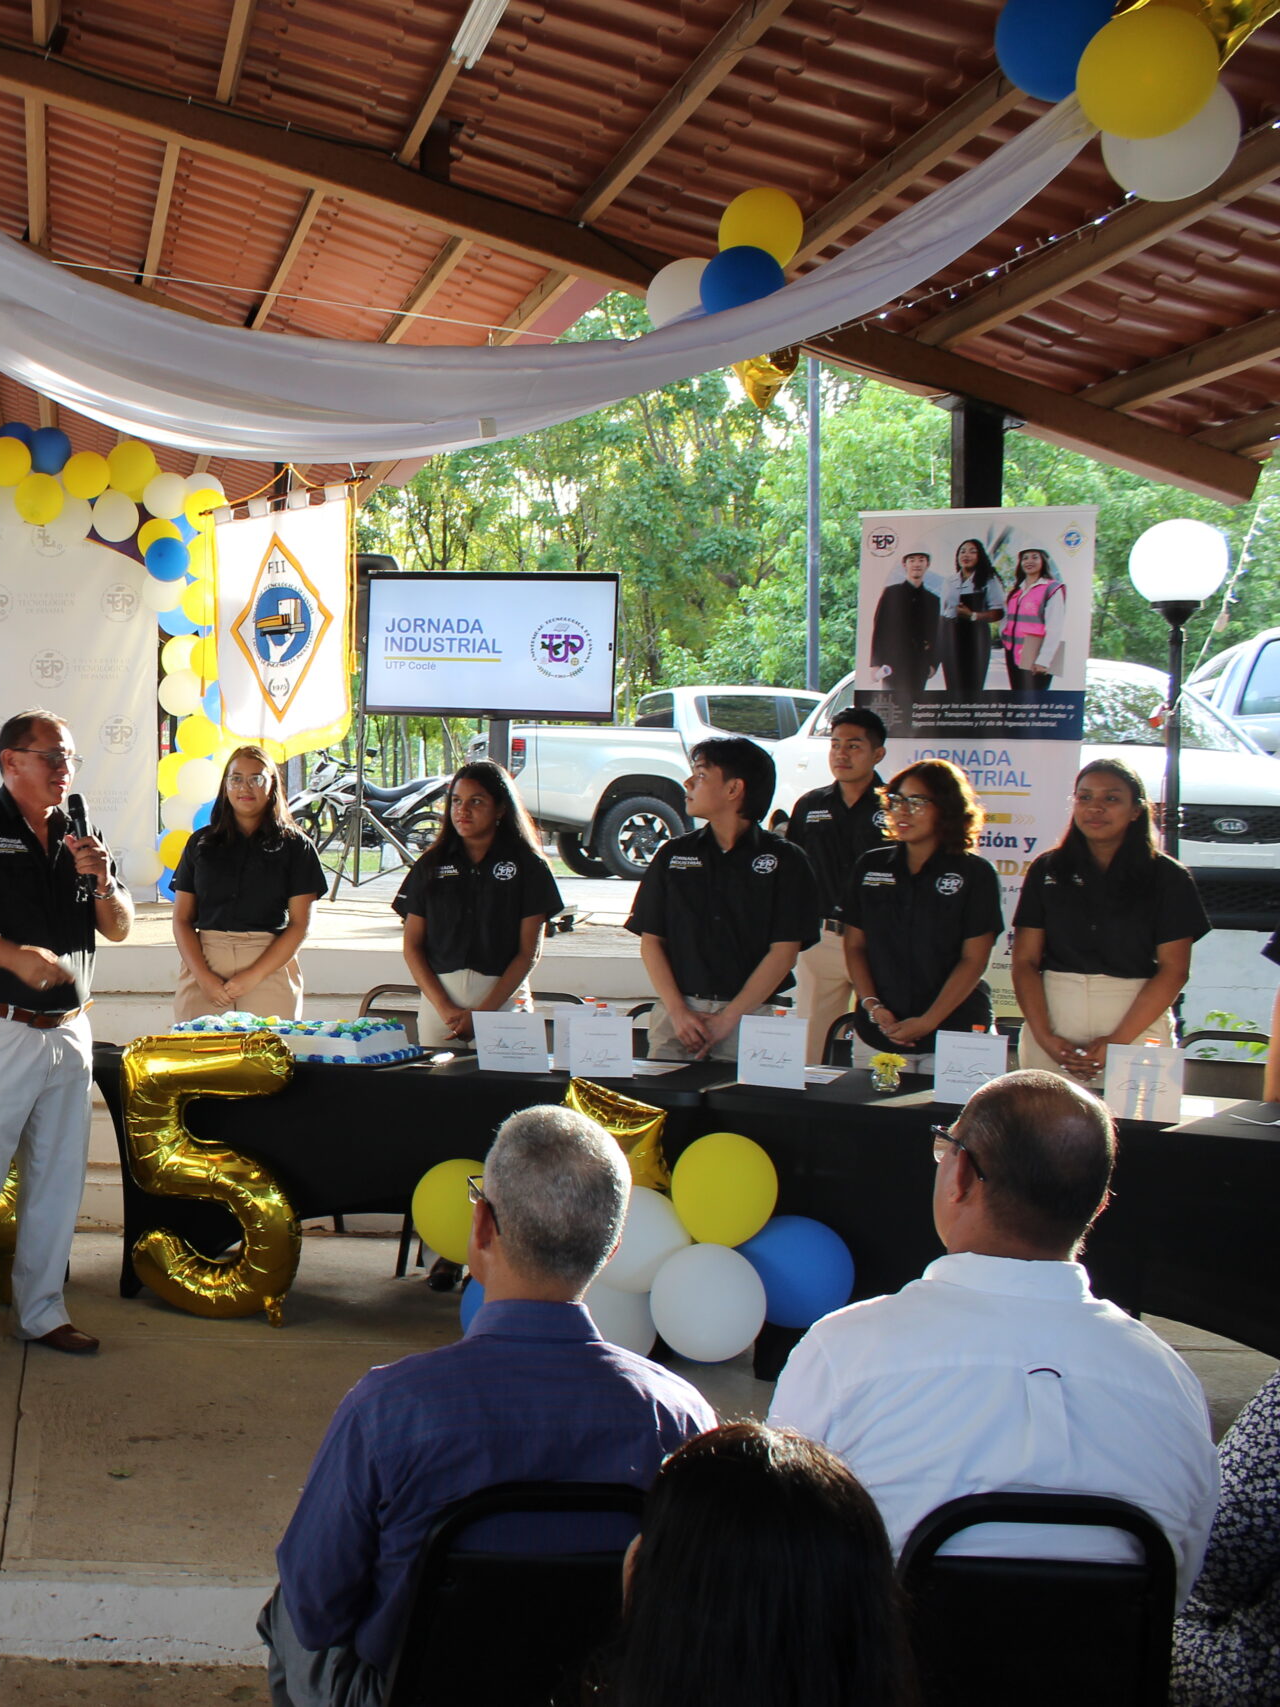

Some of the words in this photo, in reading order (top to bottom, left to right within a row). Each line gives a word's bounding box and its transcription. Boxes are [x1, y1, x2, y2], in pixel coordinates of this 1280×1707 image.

[267, 560, 286, 574] FII
[385, 617, 484, 635] JORNADA
[384, 636, 503, 654] INDUSTRIAL
[385, 661, 406, 670] UTP
[408, 660, 437, 671] Coclé
[908, 749, 1012, 766] JORNADA
[1221, 821, 1243, 830] KIA
[977, 831, 1018, 848] ción
[1023, 837, 1038, 853] y
